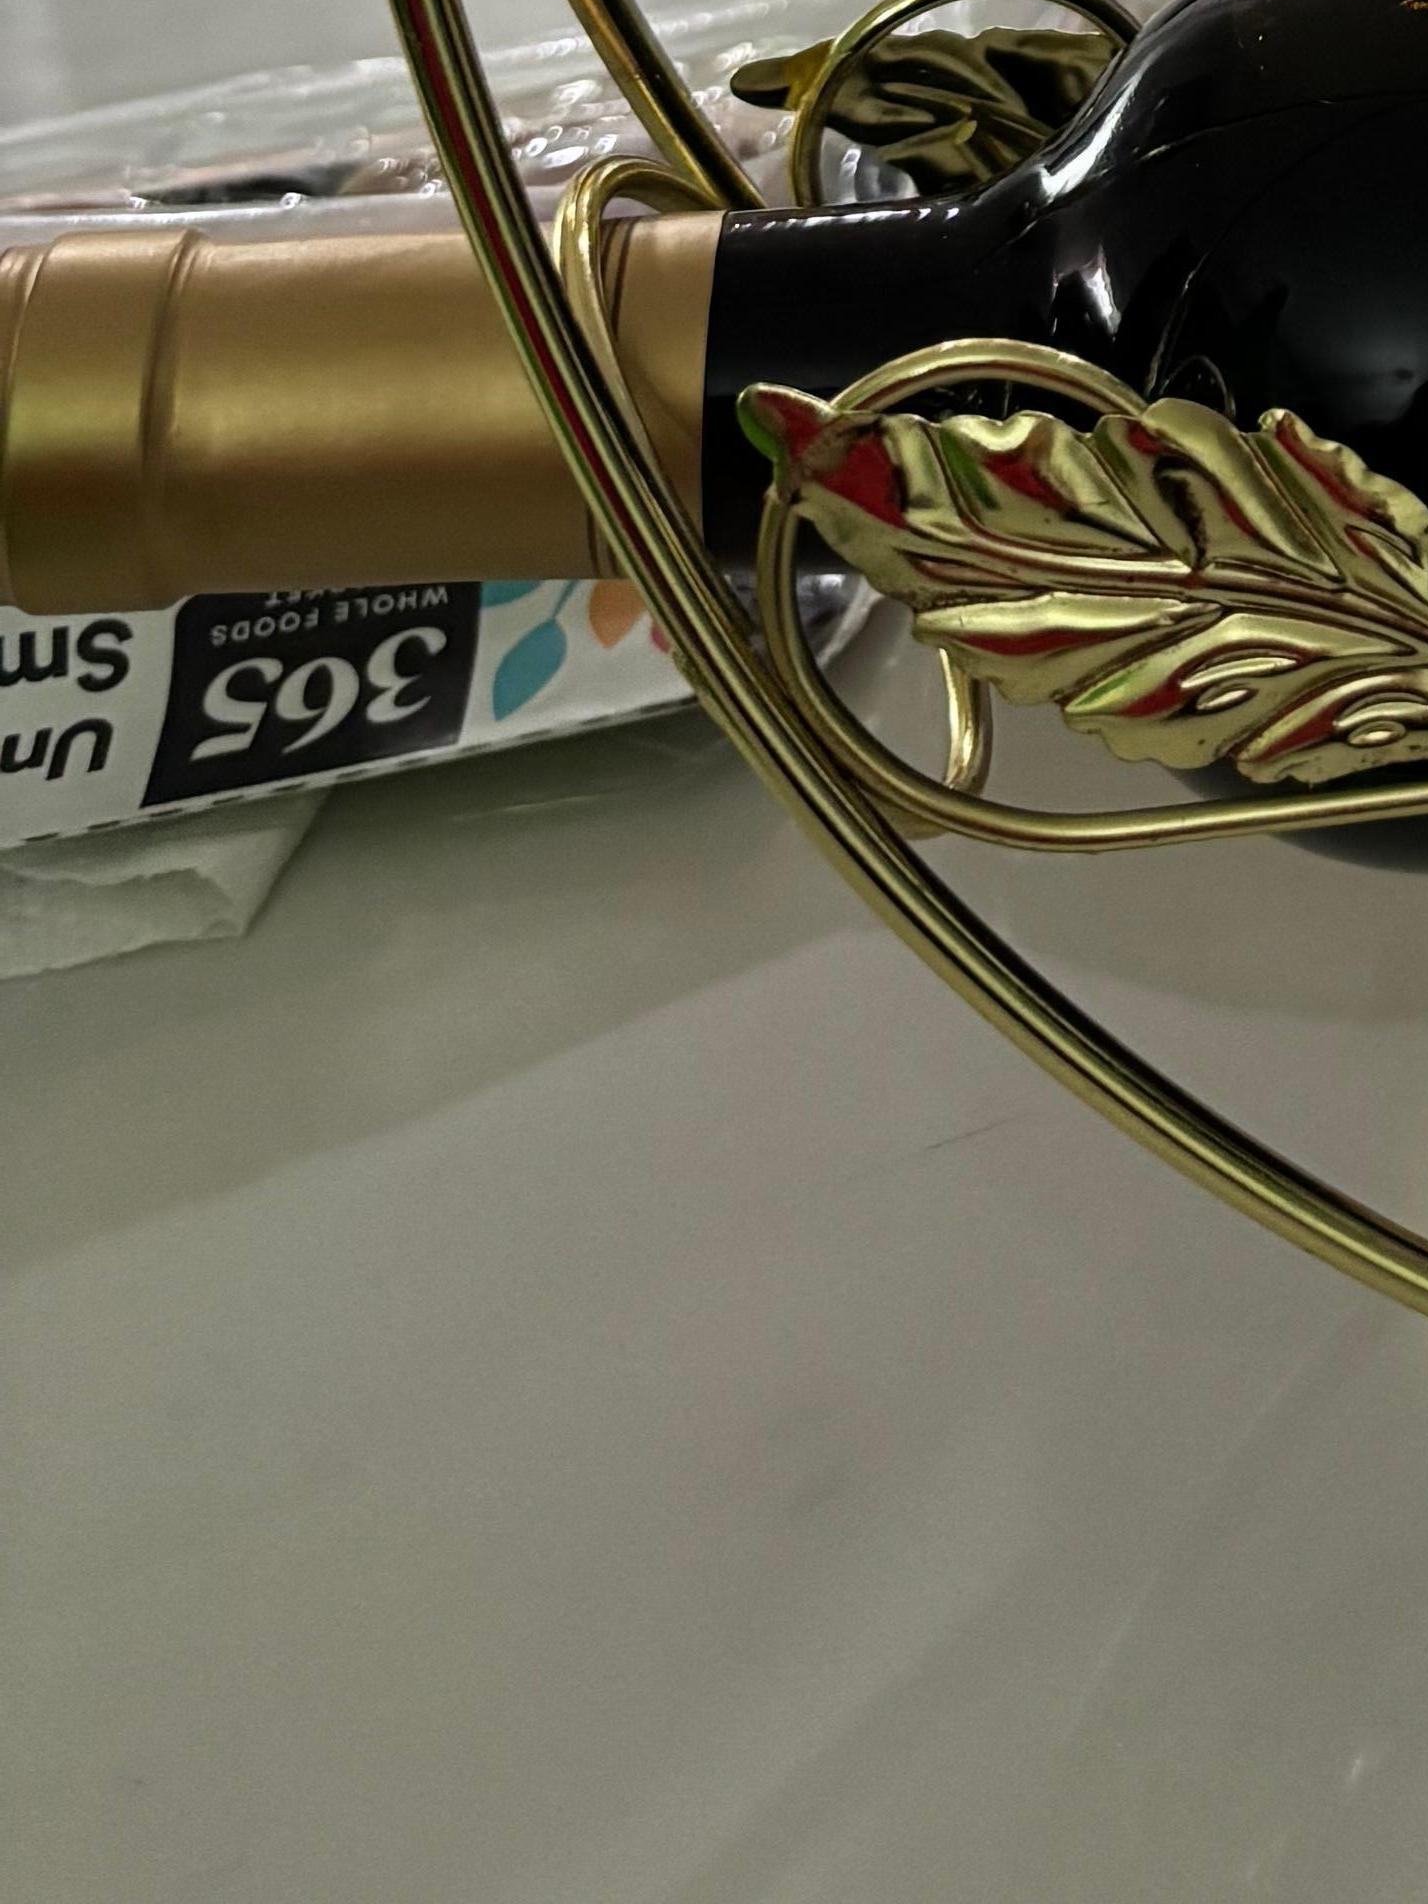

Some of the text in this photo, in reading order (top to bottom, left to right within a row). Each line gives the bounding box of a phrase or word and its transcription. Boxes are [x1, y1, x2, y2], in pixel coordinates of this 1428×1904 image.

[334, 585, 449, 624] WHOLE
[208, 606, 319, 648] FOODS
[189, 625, 448, 762] 365
